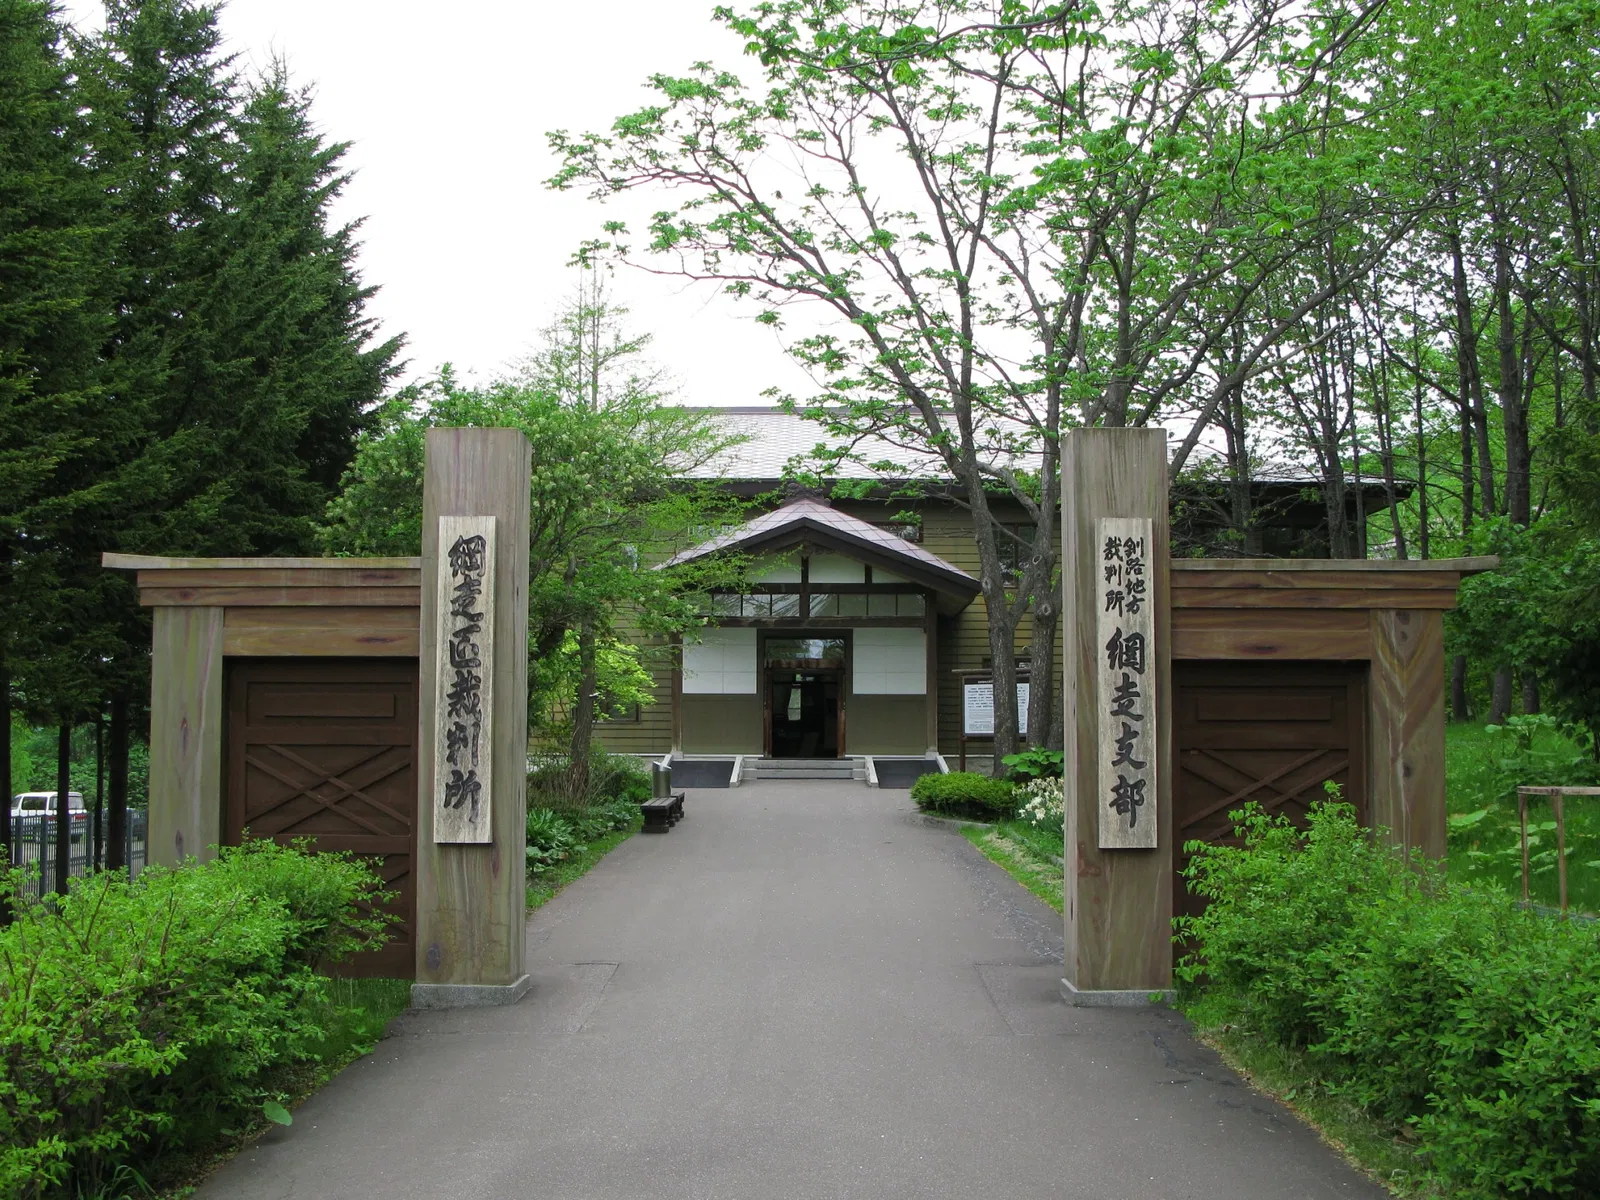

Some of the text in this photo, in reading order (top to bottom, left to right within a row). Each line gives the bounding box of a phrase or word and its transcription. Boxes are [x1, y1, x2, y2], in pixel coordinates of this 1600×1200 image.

[1103, 536, 1125, 617] 裁判所
[1123, 536, 1146, 615] 釧路地方
[1105, 626, 1147, 828] 網走支部
